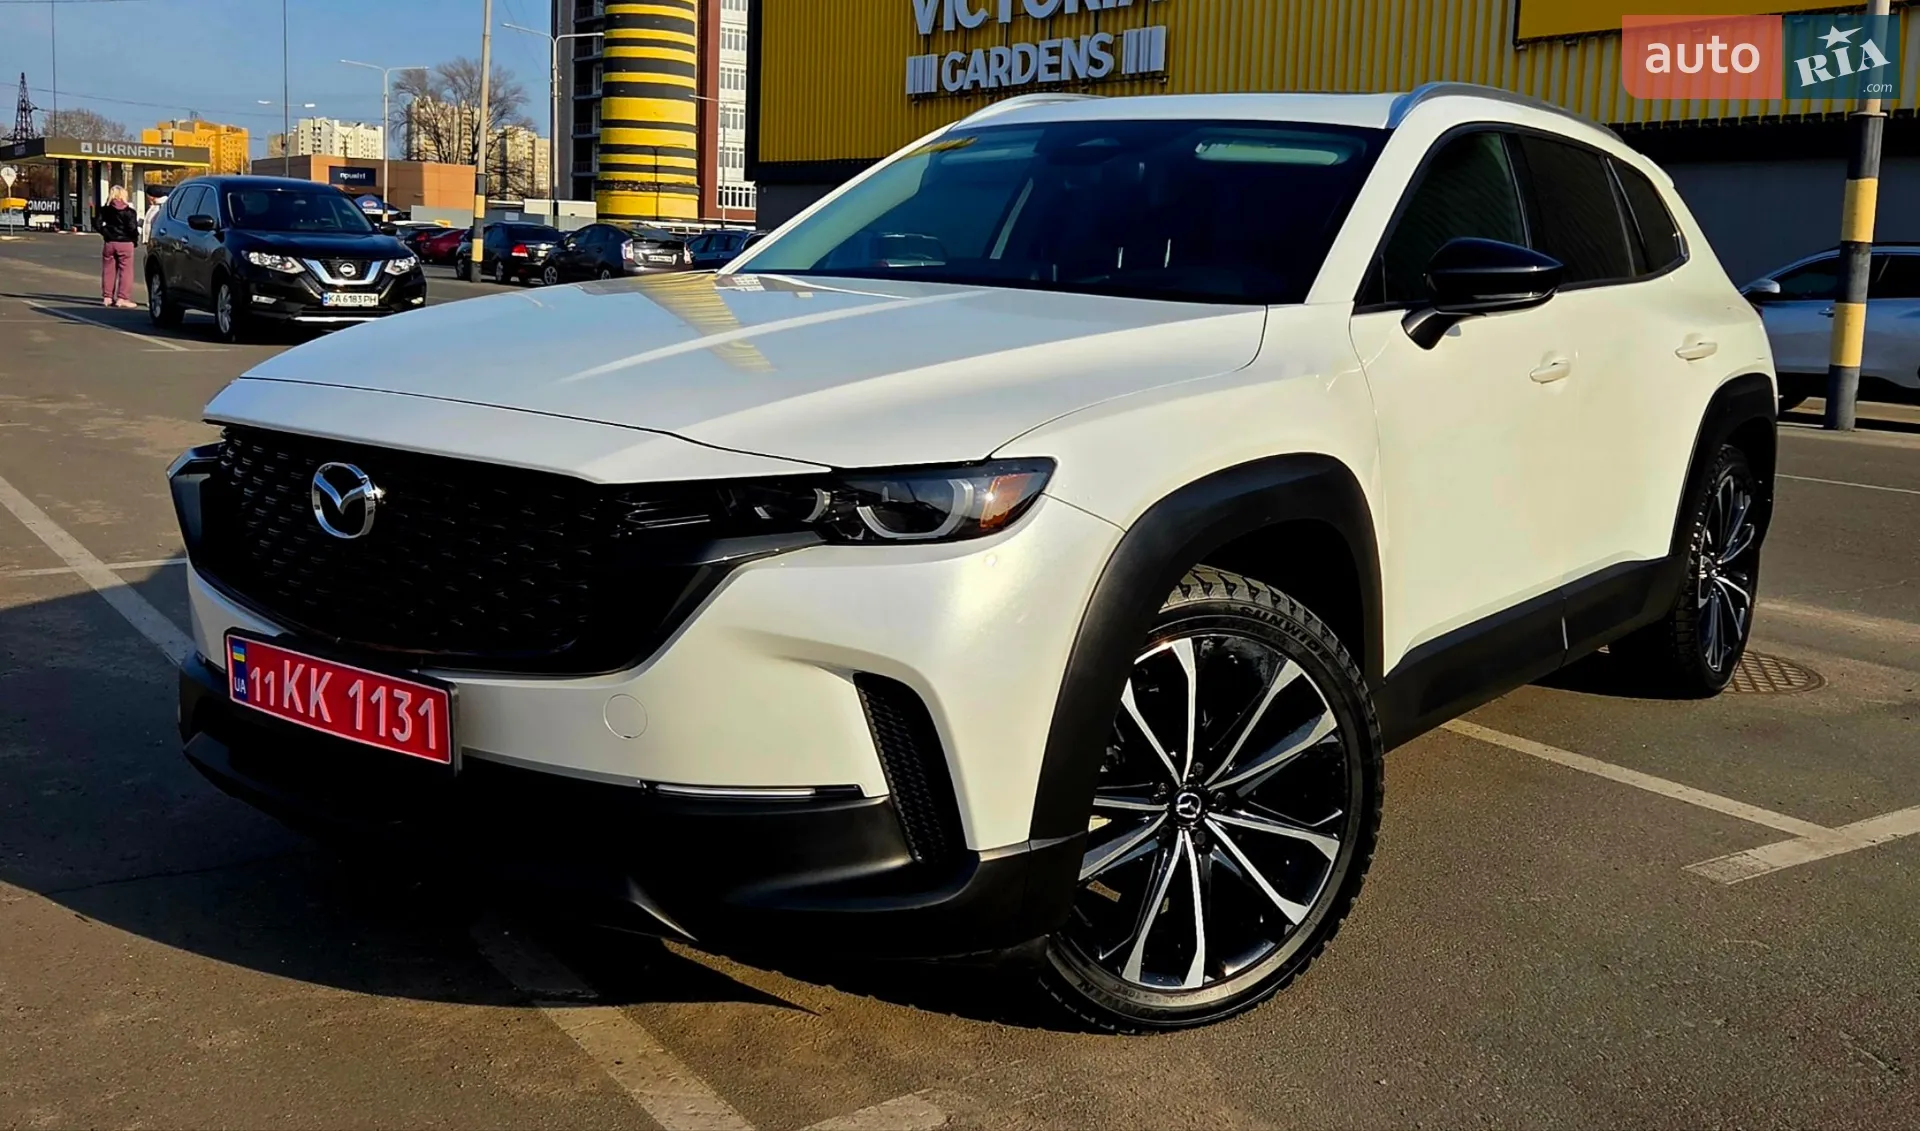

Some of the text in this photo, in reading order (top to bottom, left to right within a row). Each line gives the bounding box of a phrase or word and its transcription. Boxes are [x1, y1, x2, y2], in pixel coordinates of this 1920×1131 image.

[941, 32, 1115, 92] GARDENS
[97, 143, 175, 158] UKRNAFTA
[234, 678, 247, 695] UA
[348, 679, 436, 750] 1131
